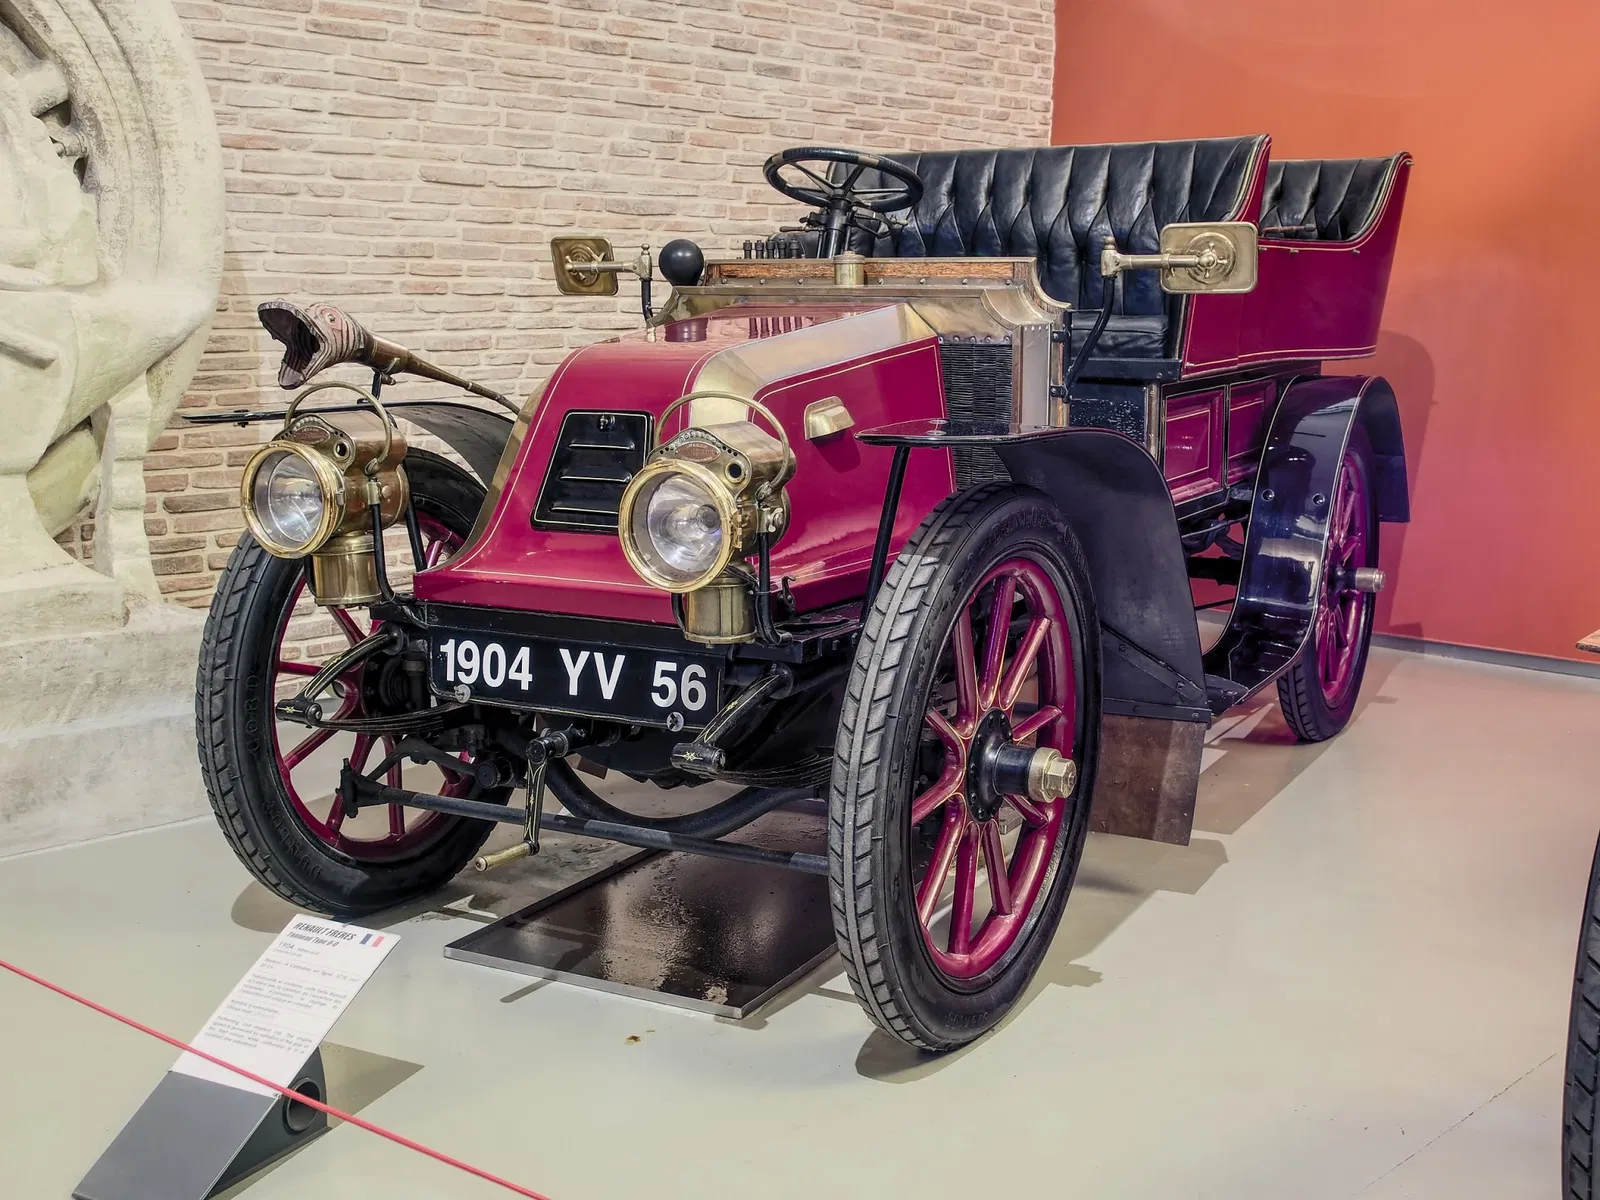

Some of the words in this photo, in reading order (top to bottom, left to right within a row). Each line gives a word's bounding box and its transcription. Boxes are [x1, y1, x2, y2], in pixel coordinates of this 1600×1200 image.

[440, 638, 533, 691] 1904
[559, 648, 626, 700] YV
[651, 661, 707, 712] 56
[245, 675, 260, 752] CORD
[293, 922, 330, 935] RENAULT
[279, 941, 295, 949] 1904
[311, 936, 327, 946] Type
